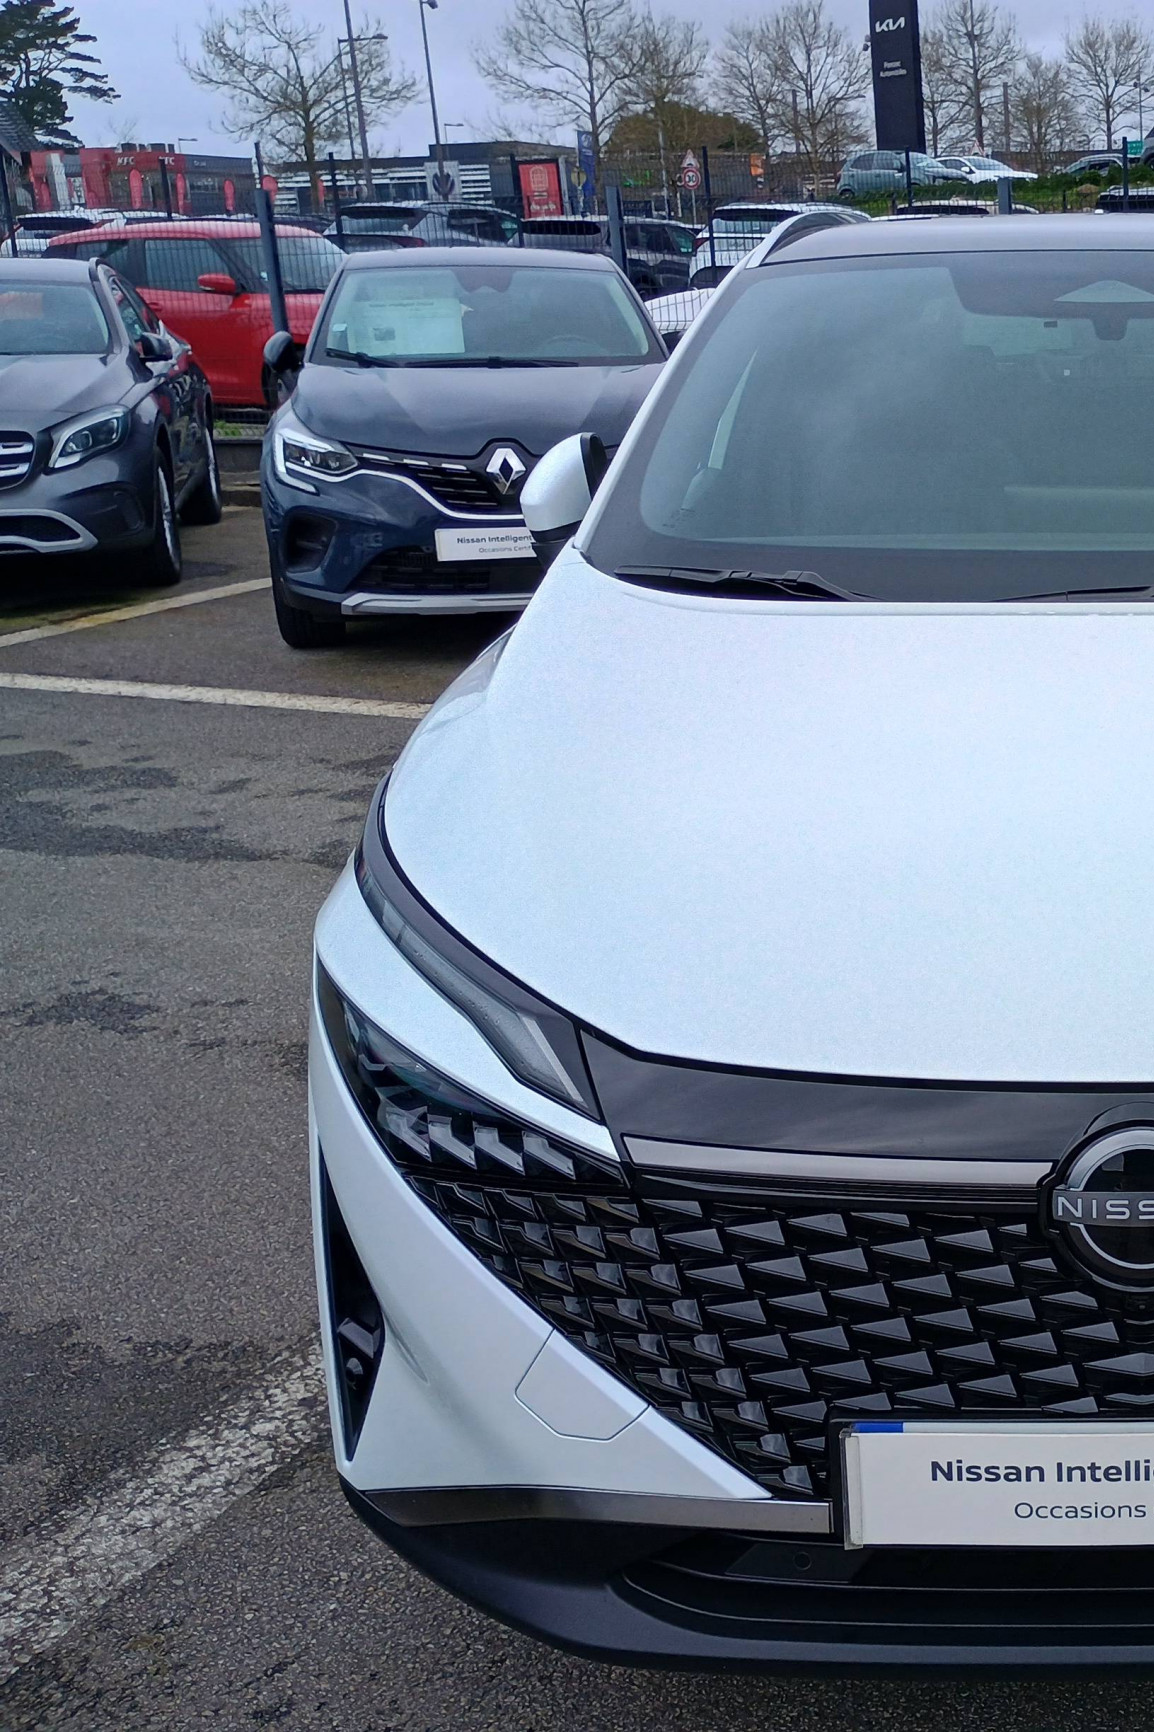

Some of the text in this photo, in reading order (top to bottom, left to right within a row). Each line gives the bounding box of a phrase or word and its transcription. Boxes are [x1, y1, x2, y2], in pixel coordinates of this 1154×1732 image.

[117, 156, 134, 165] KFC
[457, 535, 532, 544] Nissan Intelligent
[930, 1460, 1046, 1483] Nissan
[1013, 1500, 1147, 1520] Occasions
